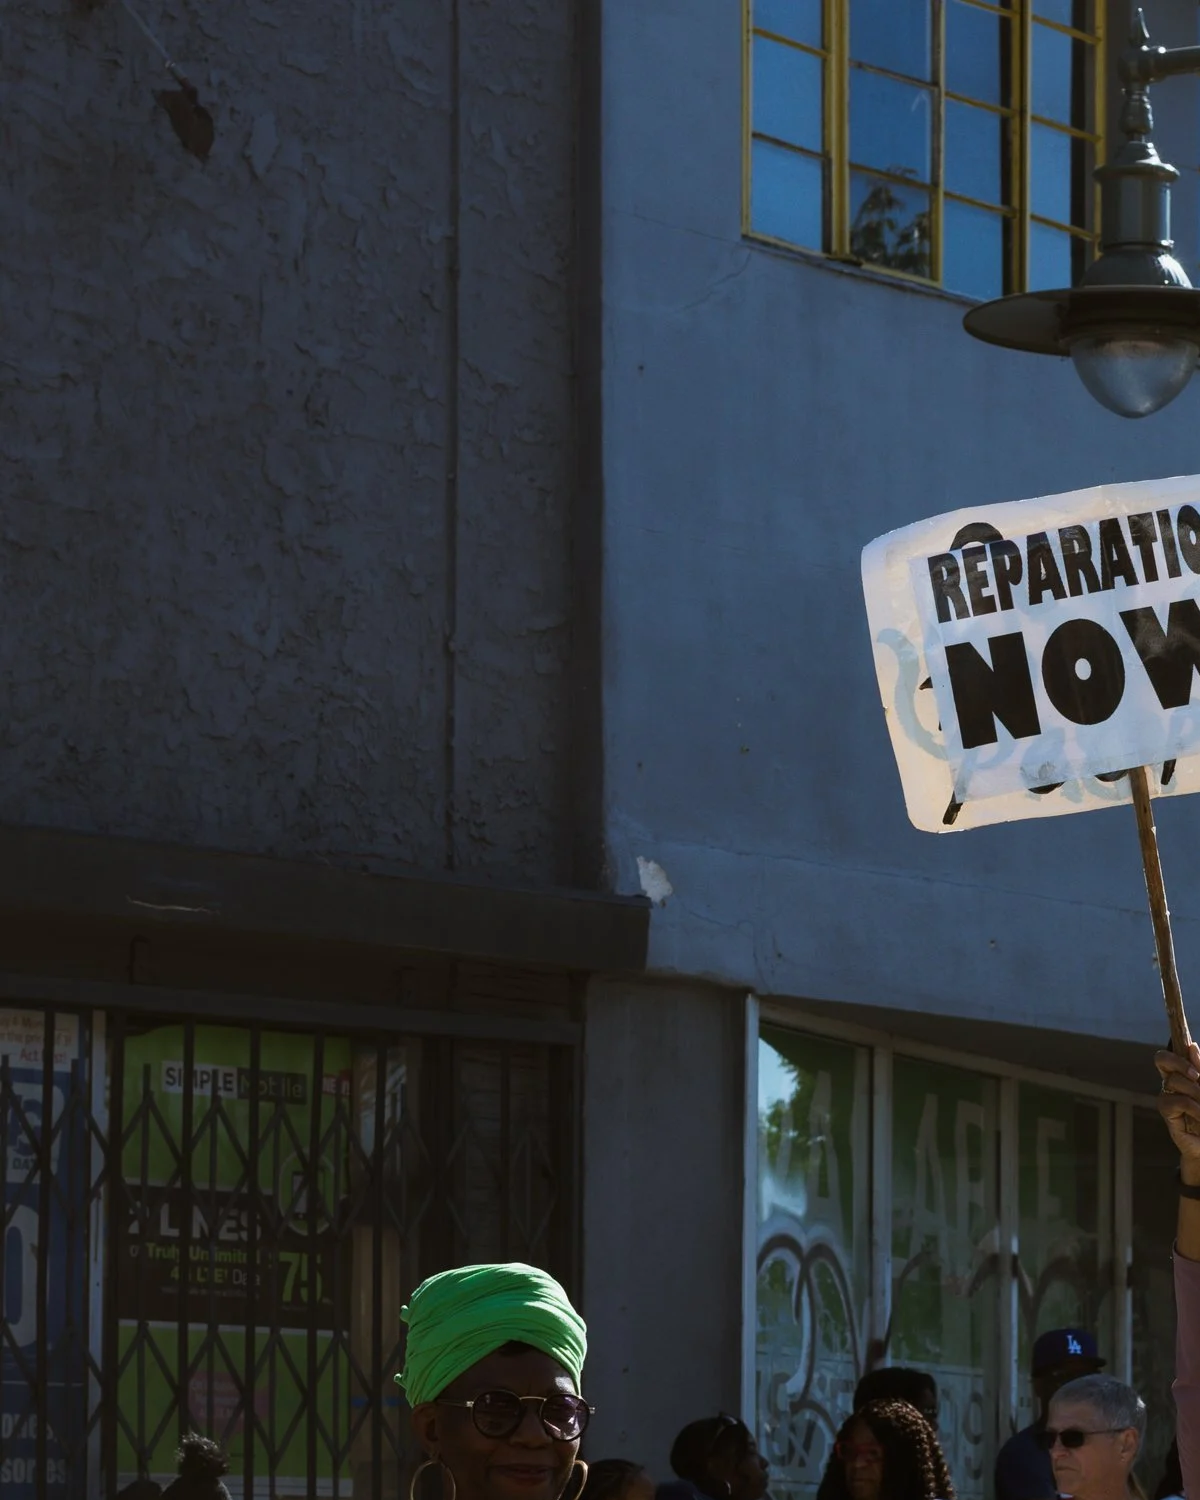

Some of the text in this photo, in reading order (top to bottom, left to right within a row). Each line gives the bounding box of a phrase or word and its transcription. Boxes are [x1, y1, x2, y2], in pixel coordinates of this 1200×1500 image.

[165, 1067, 234, 1092] SIPE
[160, 1203, 262, 1241] LNES
[1066, 1334, 1083, 1355] LA
[0, 1458, 67, 1485] sores
